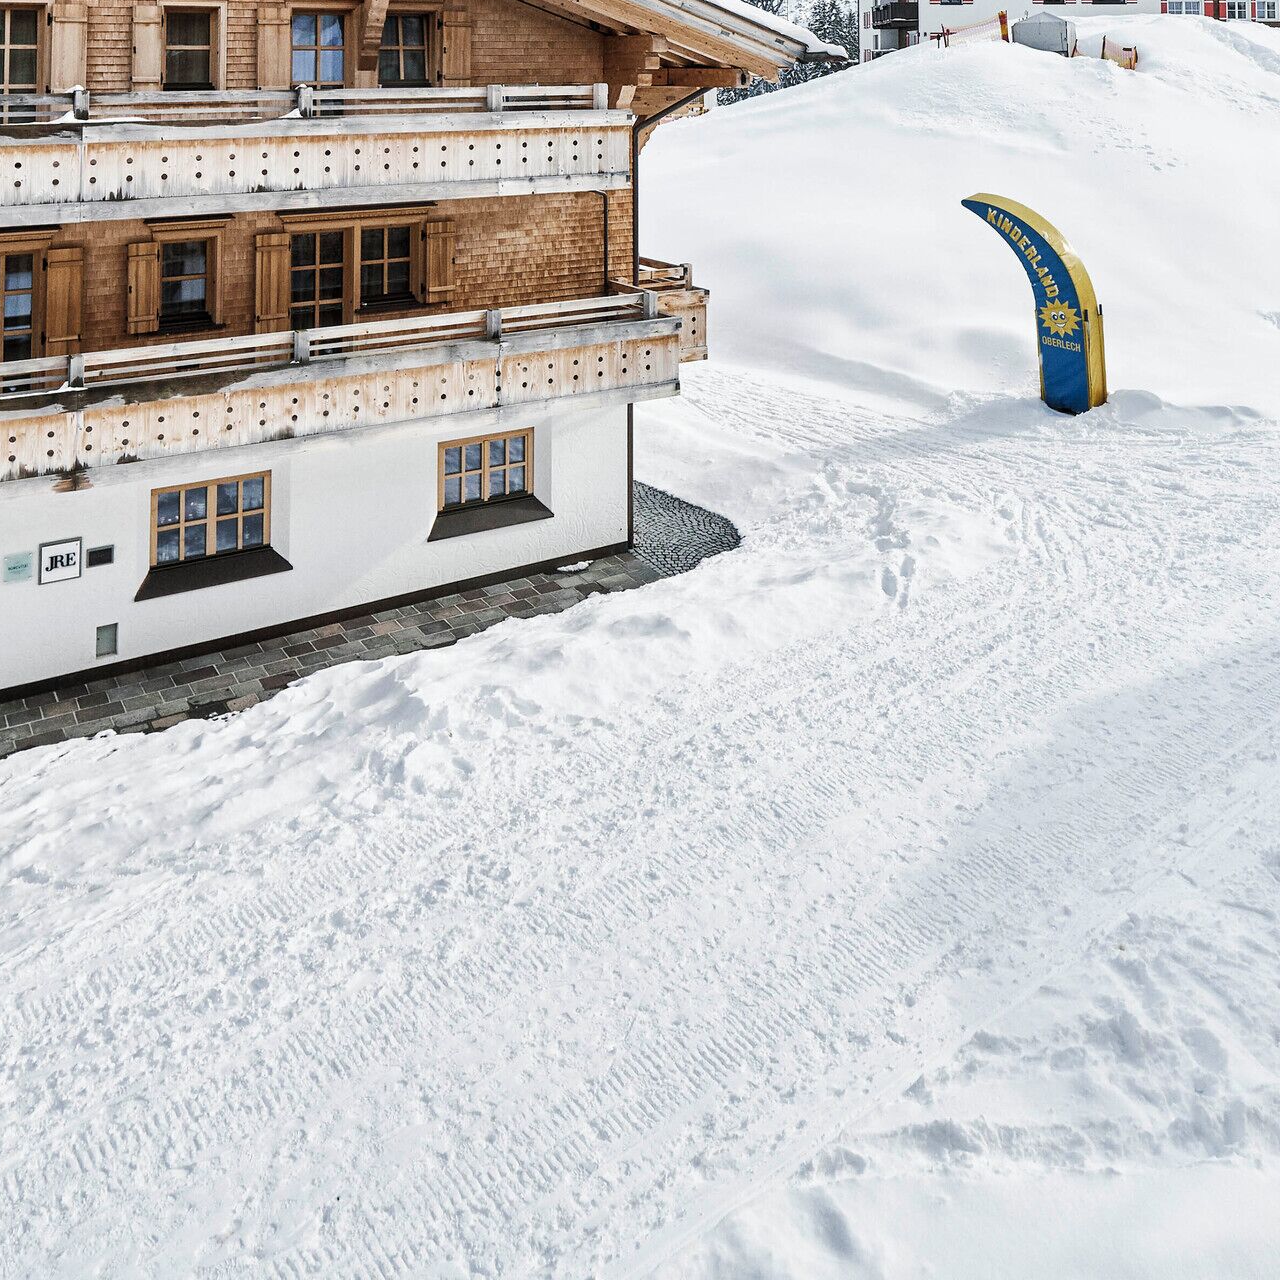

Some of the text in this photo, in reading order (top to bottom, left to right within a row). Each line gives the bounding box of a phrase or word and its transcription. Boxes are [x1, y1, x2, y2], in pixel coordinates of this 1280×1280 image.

[986, 207, 1060, 298] KINDERLAND
[1041, 336, 1081, 352] OBERLECH
[45, 552, 77, 572] JRE
